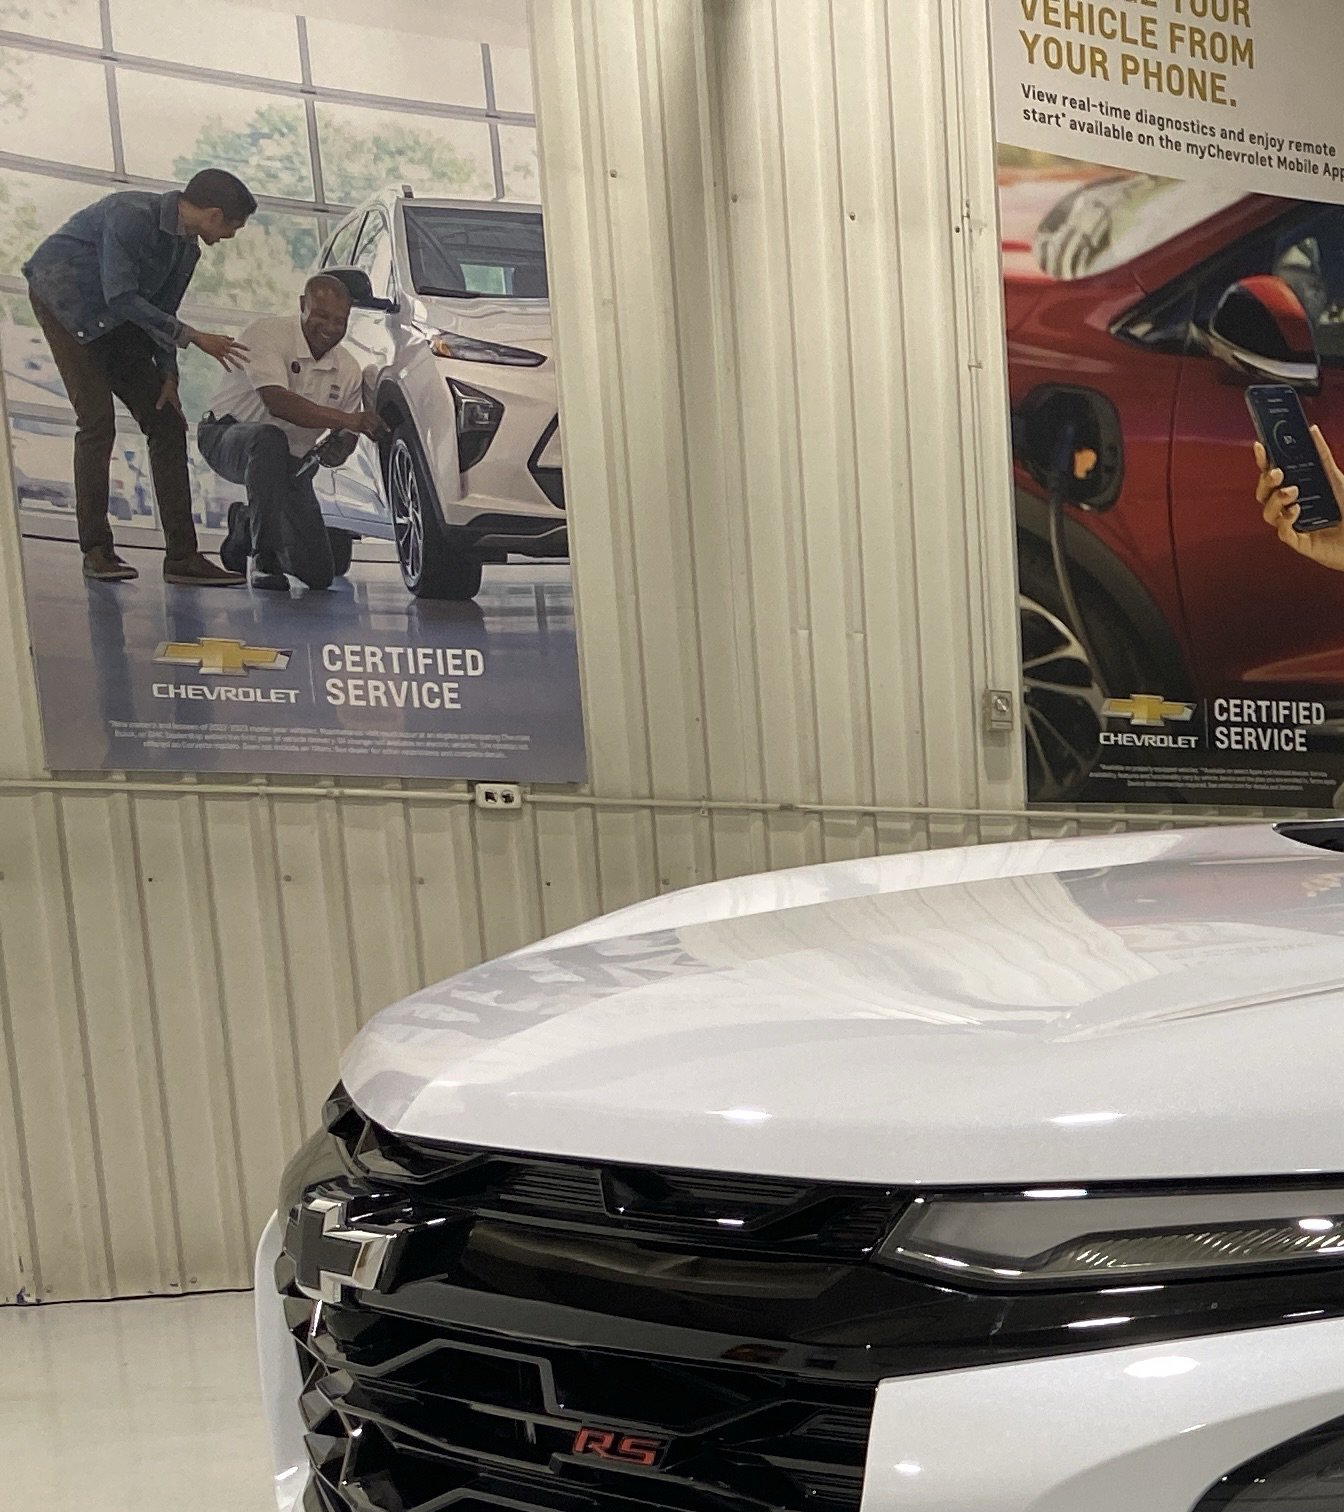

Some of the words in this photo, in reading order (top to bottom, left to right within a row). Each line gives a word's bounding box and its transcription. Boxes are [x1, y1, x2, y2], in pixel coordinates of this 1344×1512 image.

[1020, 0, 1158, 50] VEHICLE
[1169, 22, 1254, 69] FROM
[1019, 29, 1110, 81] YOUR
[1121, 53, 1237, 107] PHONE.
[1020, 83, 1057, 106] View
[1062, 93, 1131, 121] real-time
[1135, 112, 1216, 138] diagnostics
[1220, 127, 1245, 143] and
[1249, 132, 1285, 153] enjoy
[1288, 139, 1336, 158] remote
[1069, 117, 1134, 143] available
[1138, 131, 1155, 148] on
[1158, 134, 1182, 152] the
[1186, 143, 1273, 169] myChevrolet
[1277, 156, 1319, 176] Mobile
[322, 643, 485, 677] CERTIFIED
[152, 681, 300, 704] CHEVROLET
[326, 678, 462, 710] SERVICE
[1214, 698, 1325, 725] CERTIFIED
[1100, 732, 1198, 749] CHEVROLET
[1215, 727, 1308, 752] SERVICE
[571, 1425, 656, 1466] RS
